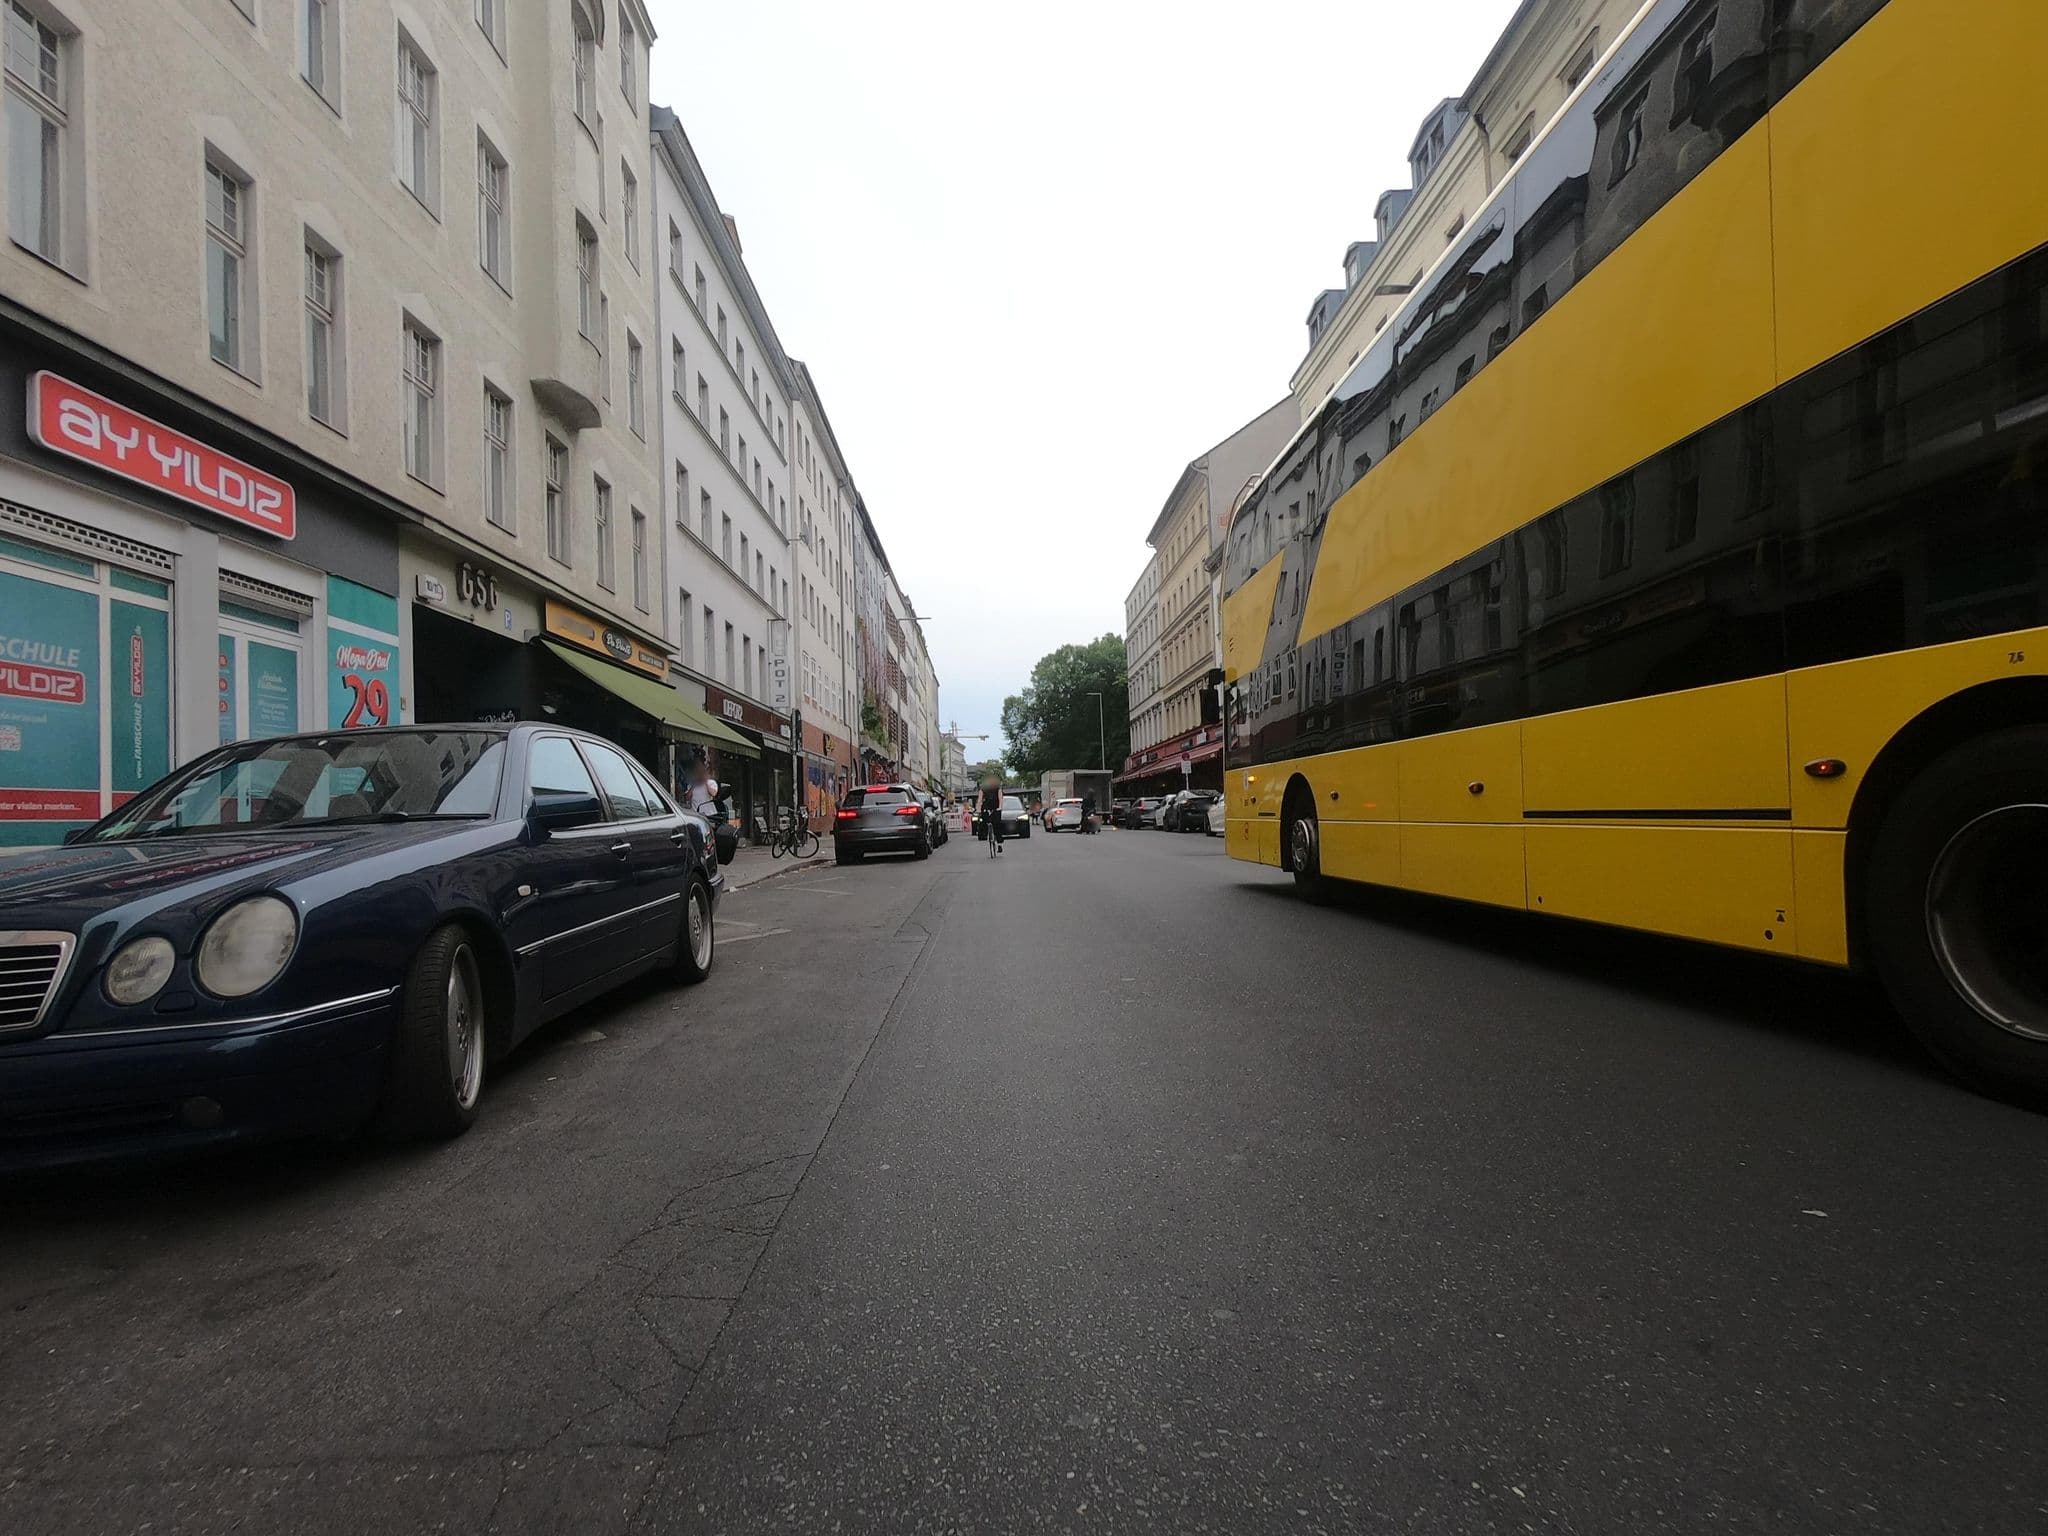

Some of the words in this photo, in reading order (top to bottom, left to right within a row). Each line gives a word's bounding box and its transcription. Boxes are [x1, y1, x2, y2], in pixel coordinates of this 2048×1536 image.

[147, 434, 282, 524] YILDIZ
[458, 562, 499, 611] GSG
[336, 645, 366, 670] Mega
[366, 649, 391, 670] Deal
[0, 668, 76, 697] ILDIZ
[341, 674, 389, 729] 29
